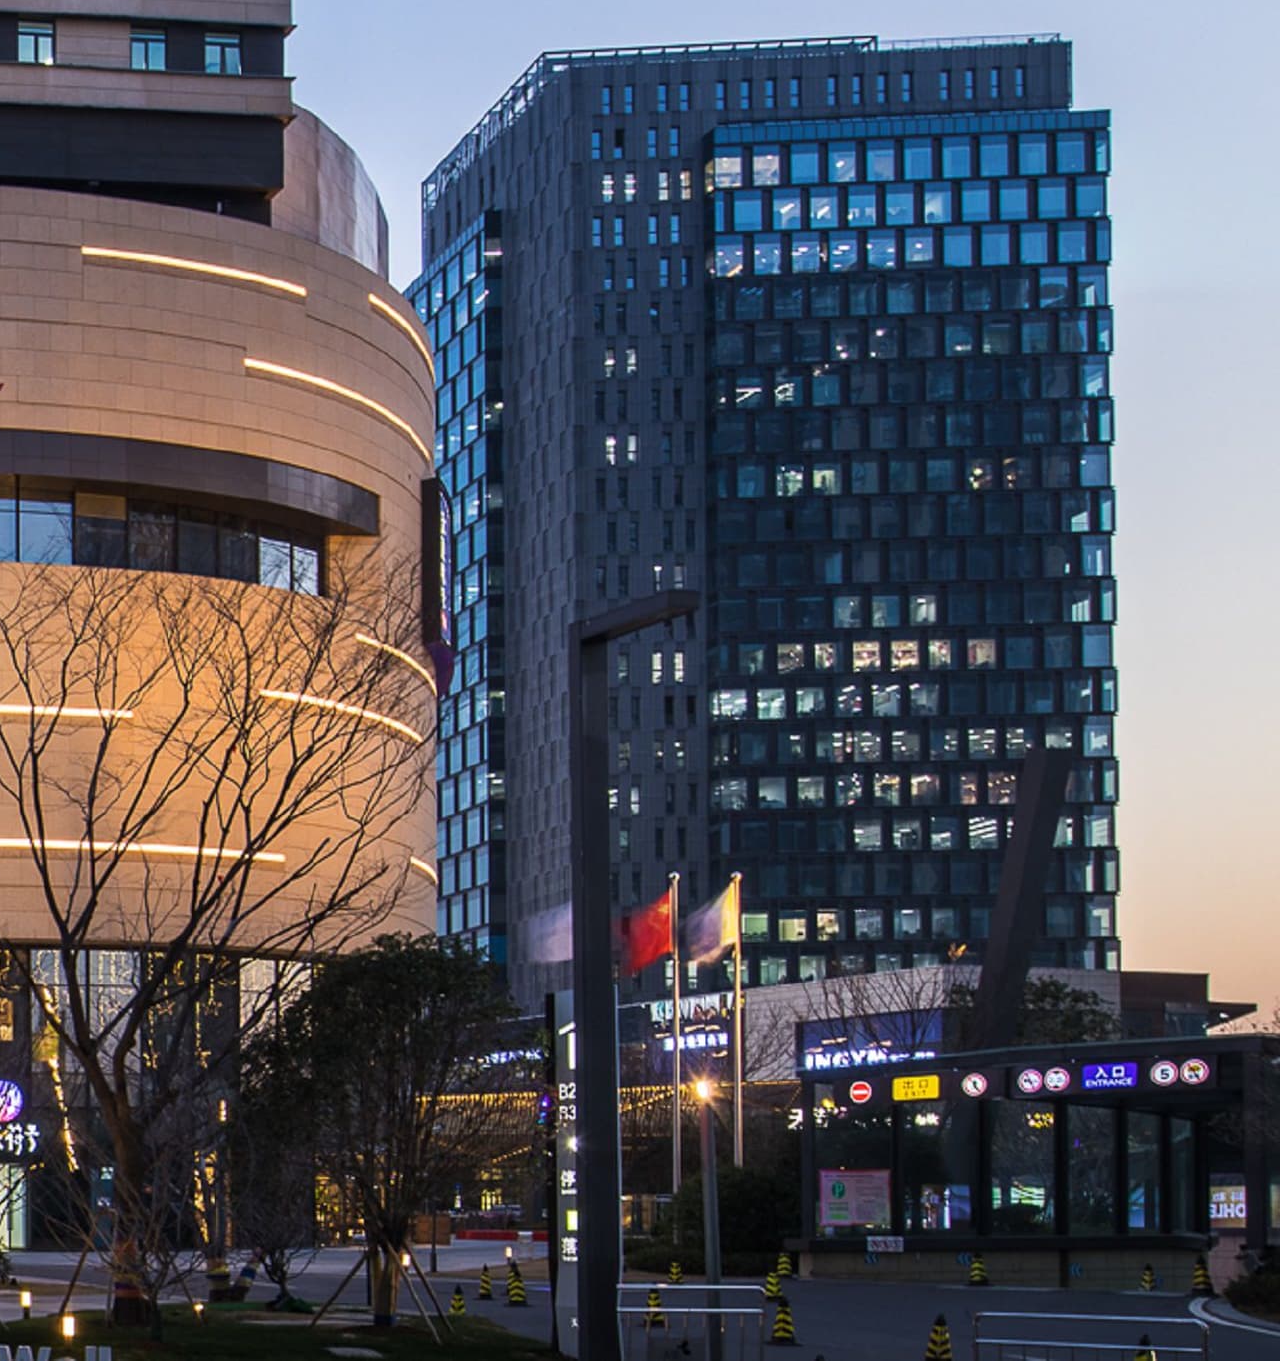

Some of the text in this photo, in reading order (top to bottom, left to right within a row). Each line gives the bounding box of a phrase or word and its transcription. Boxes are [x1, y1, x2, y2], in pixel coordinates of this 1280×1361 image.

[1095, 1066, 1126, 1078] 入口
[1159, 1068, 1171, 1080] 5
[1085, 1077, 1134, 1089] ENTRANCE
